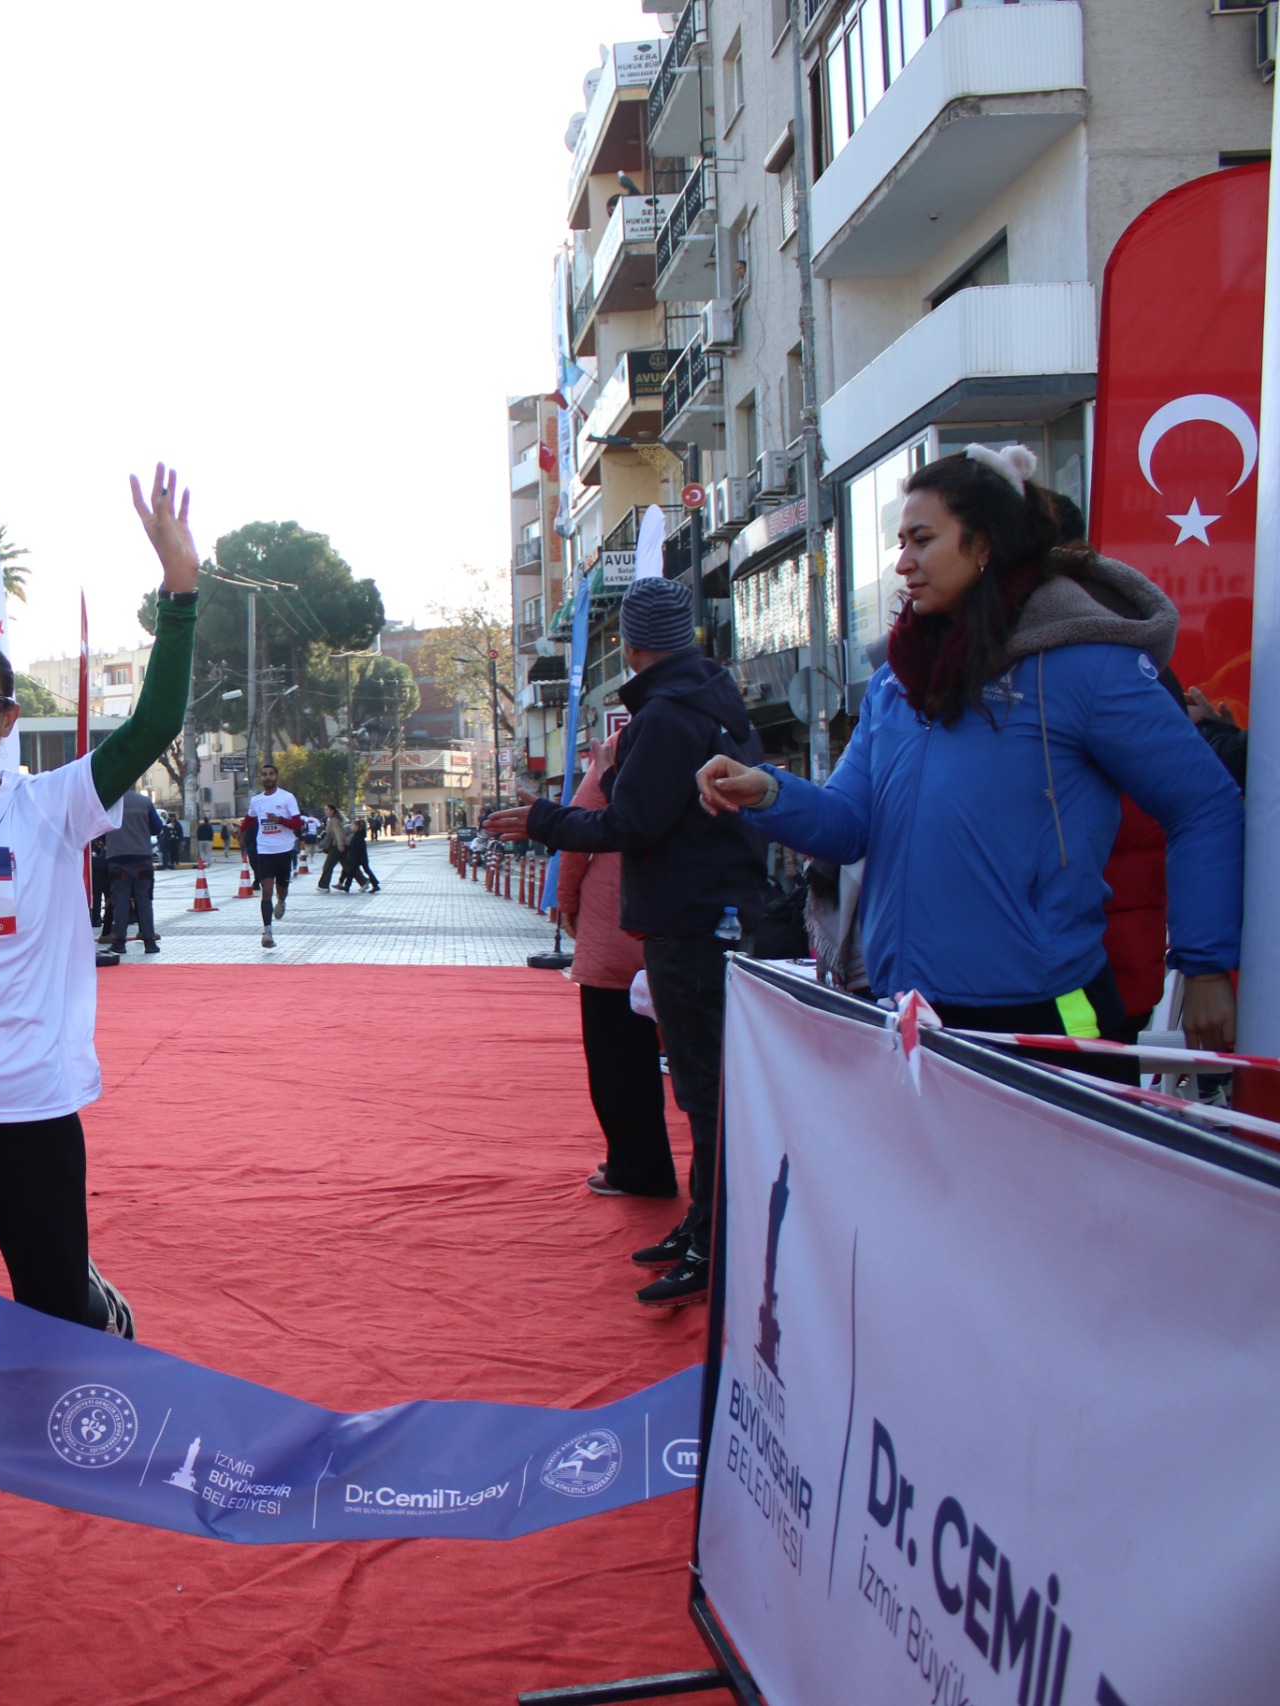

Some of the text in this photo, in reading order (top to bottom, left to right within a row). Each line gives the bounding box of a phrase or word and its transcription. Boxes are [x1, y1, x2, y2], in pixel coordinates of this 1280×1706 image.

[633, 53, 658, 61] SEBA
[625, 217, 651, 225] HUKUK
[641, 208, 665, 216] SEA
[753, 1352, 785, 1436] İZMİR
[214, 1450, 255, 1477] İZMİR
[729, 1378, 812, 1529] BÜYÜKŞEHİR
[208, 1469, 292, 1498] BÜYÜKŞEHİR
[867, 1416, 918, 1568] Dr.
[202, 1486, 281, 1515] BELEDİYESİ
[727, 1434, 803, 1577] BELEDİYESİ
[859, 1533, 904, 1638] İzmir
